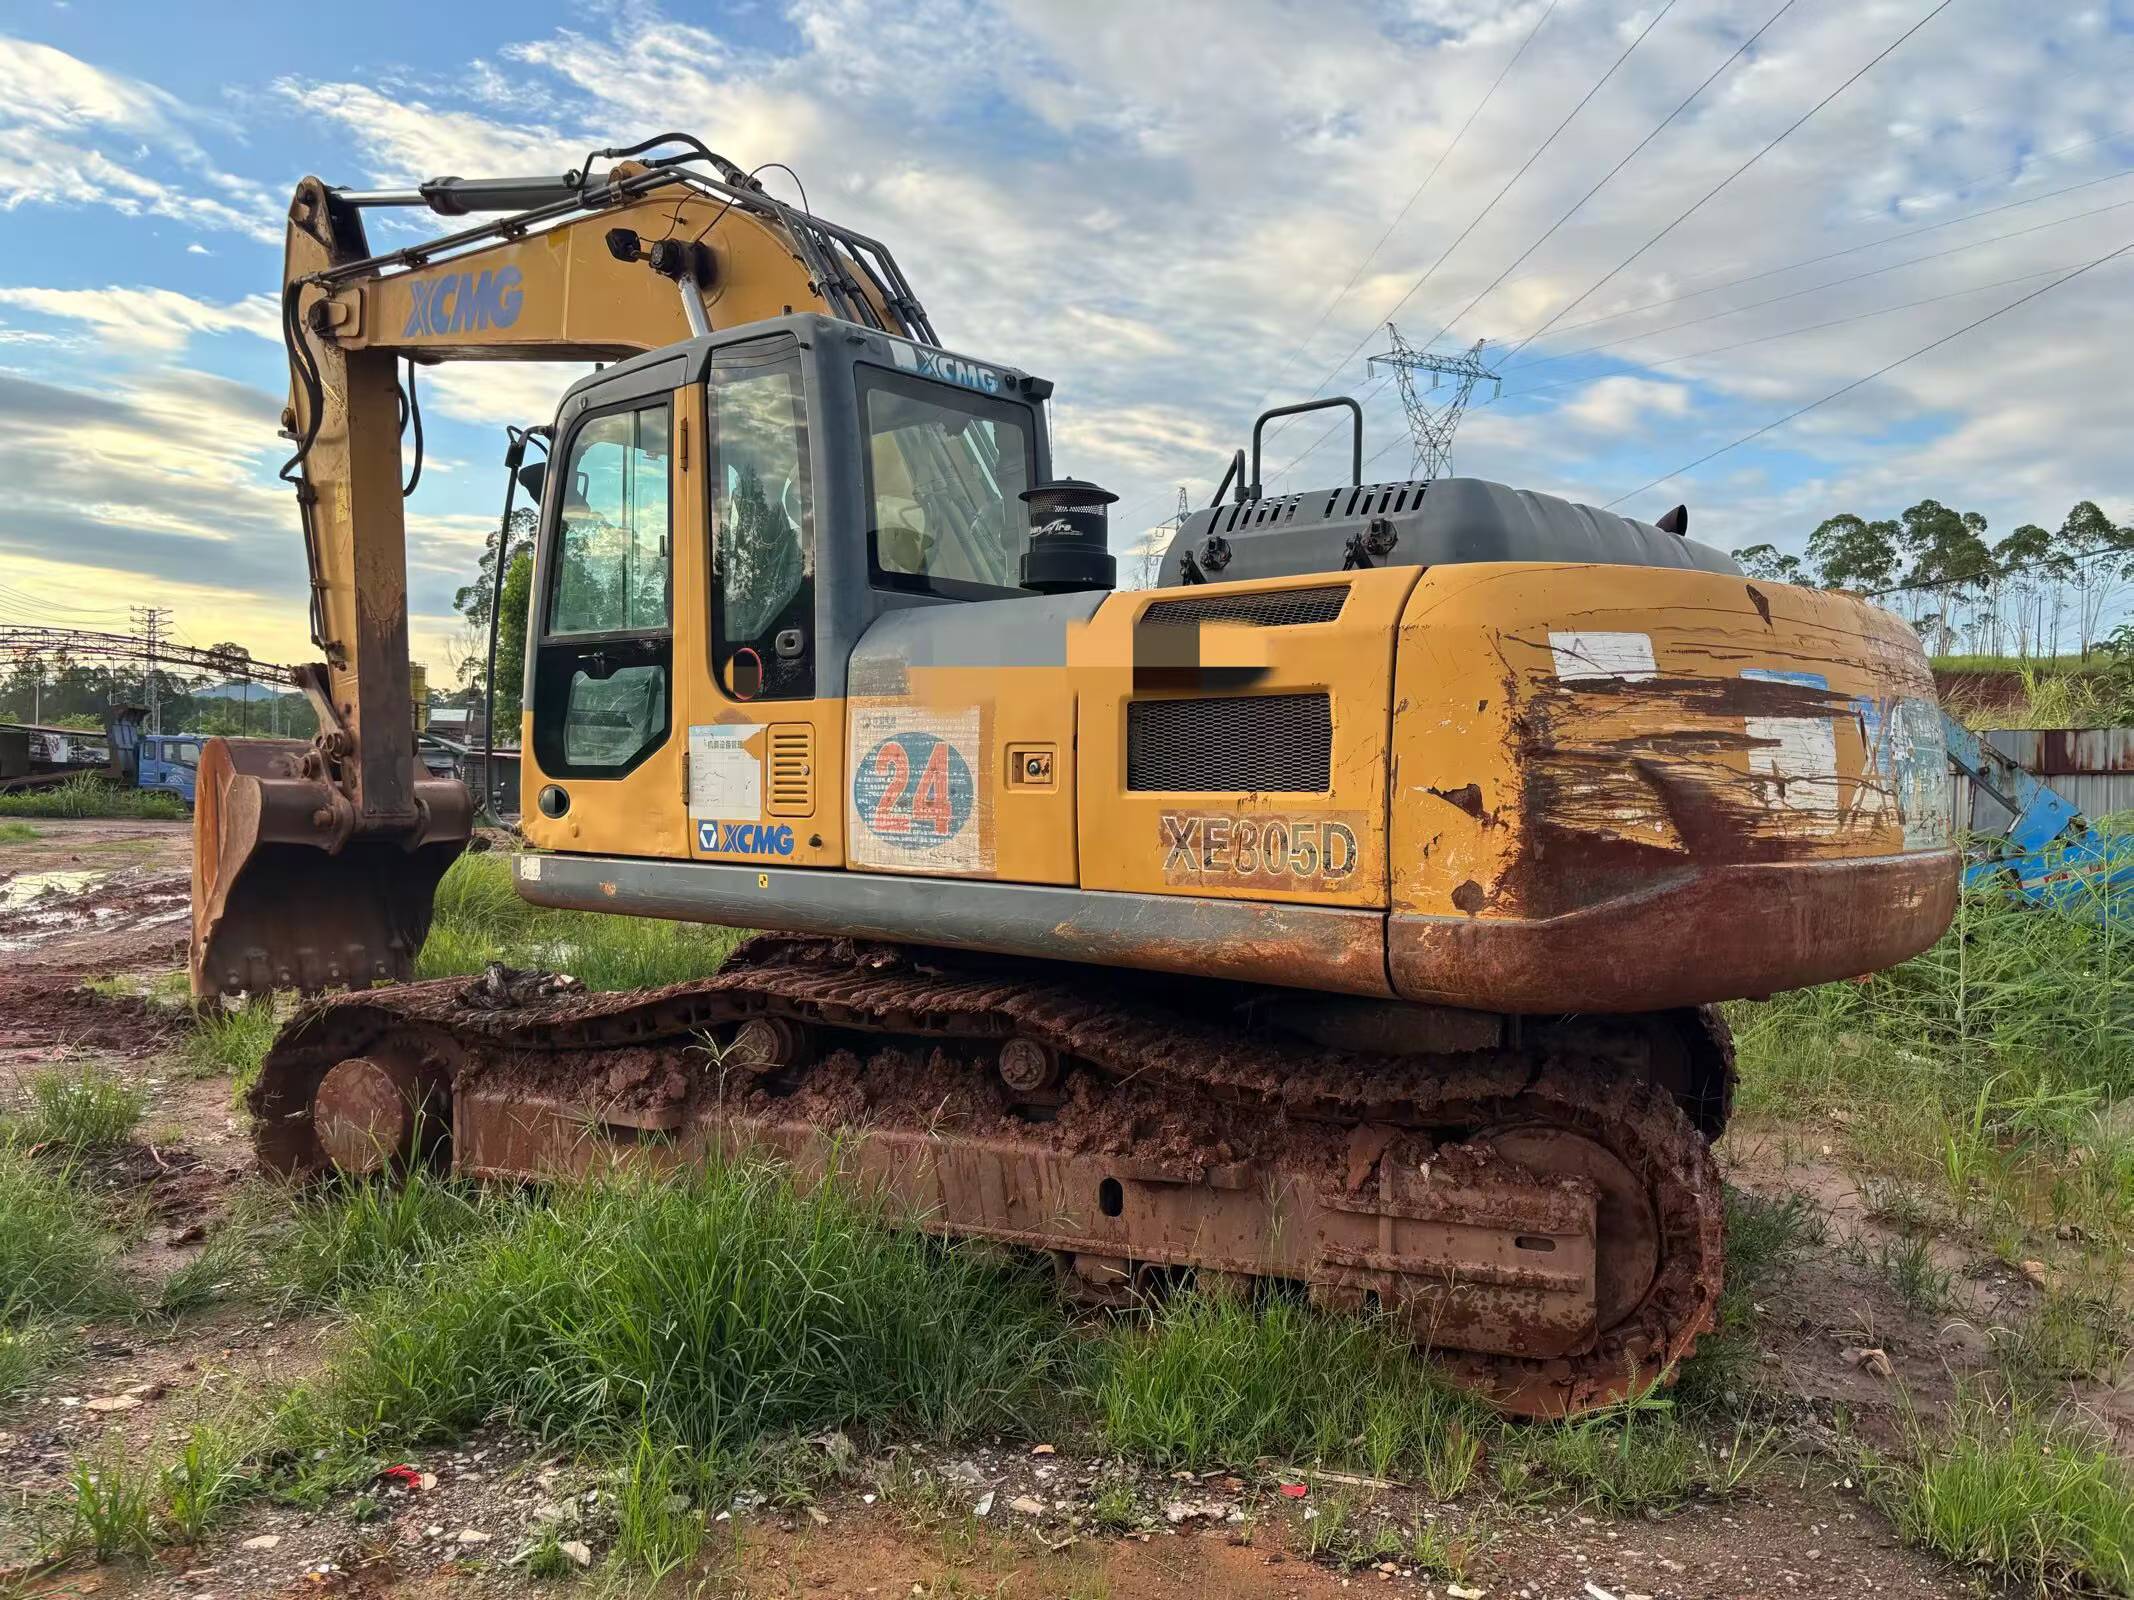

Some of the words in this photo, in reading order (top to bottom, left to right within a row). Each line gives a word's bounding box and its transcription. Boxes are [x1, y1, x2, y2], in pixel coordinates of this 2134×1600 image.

[403, 264, 524, 337] XCMG
[917, 348, 999, 393] XCMG
[875, 741, 953, 836] 24
[719, 823, 795, 856] XCMG
